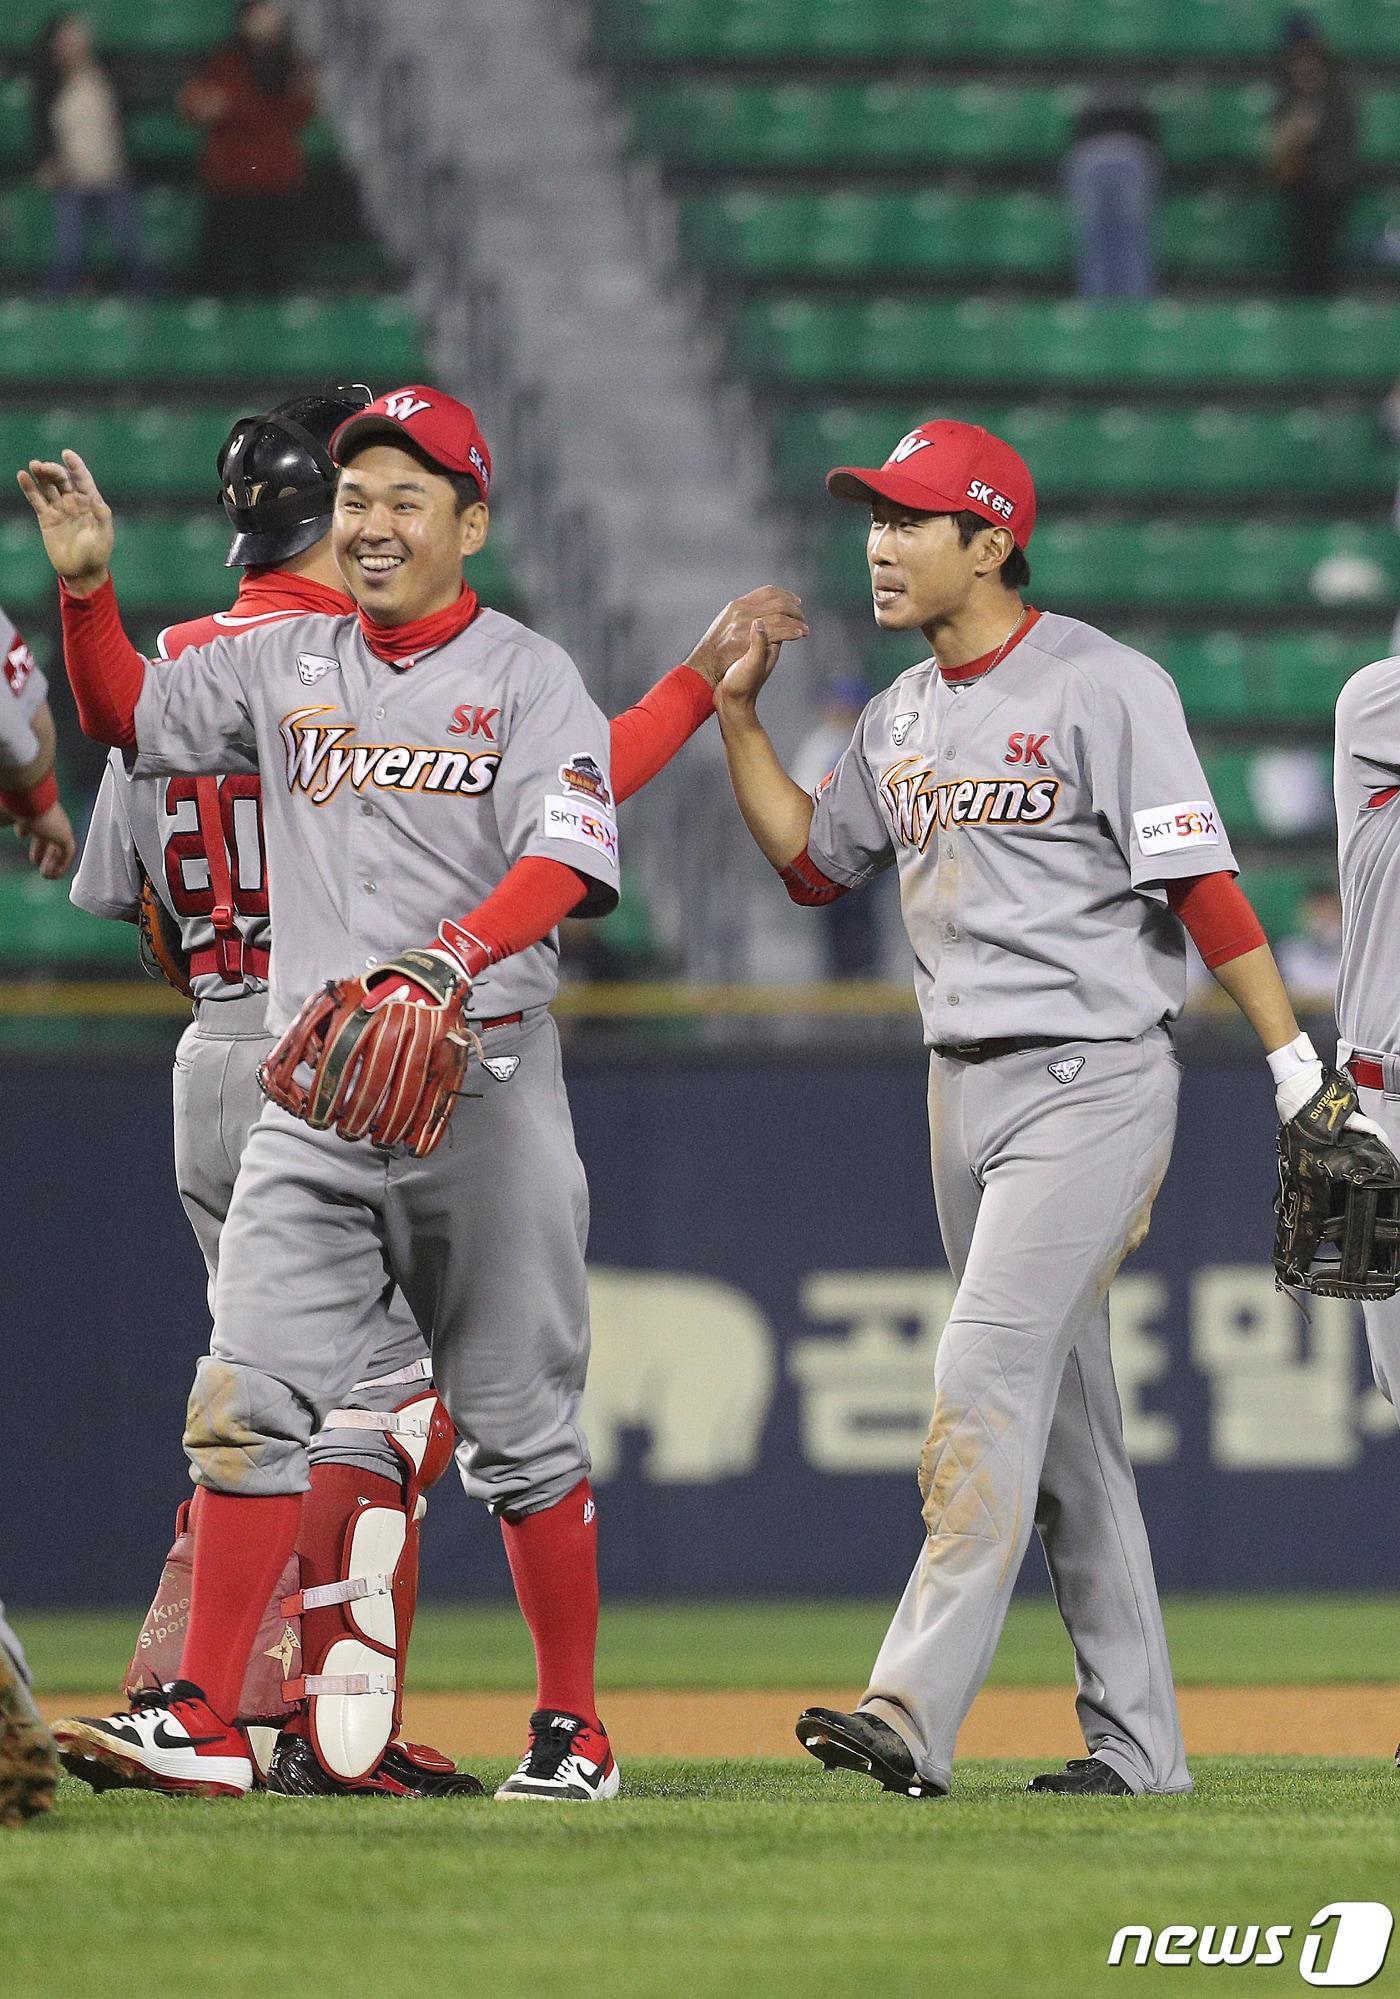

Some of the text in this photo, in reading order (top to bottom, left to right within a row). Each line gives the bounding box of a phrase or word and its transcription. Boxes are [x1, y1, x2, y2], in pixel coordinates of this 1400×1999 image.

[966, 480, 994, 505] SK
[448, 704, 500, 742] SK
[279, 706, 501, 807] Wyverns
[1003, 732, 1050, 767] SK
[550, 810, 579, 826] SKT
[880, 756, 1061, 854] Wyverns
[1142, 812, 1217, 838] SKT 5GX
[164, 774, 270, 917] 20
[152, 1598, 190, 1623] Kne
[140, 1615, 189, 1649] S'por
